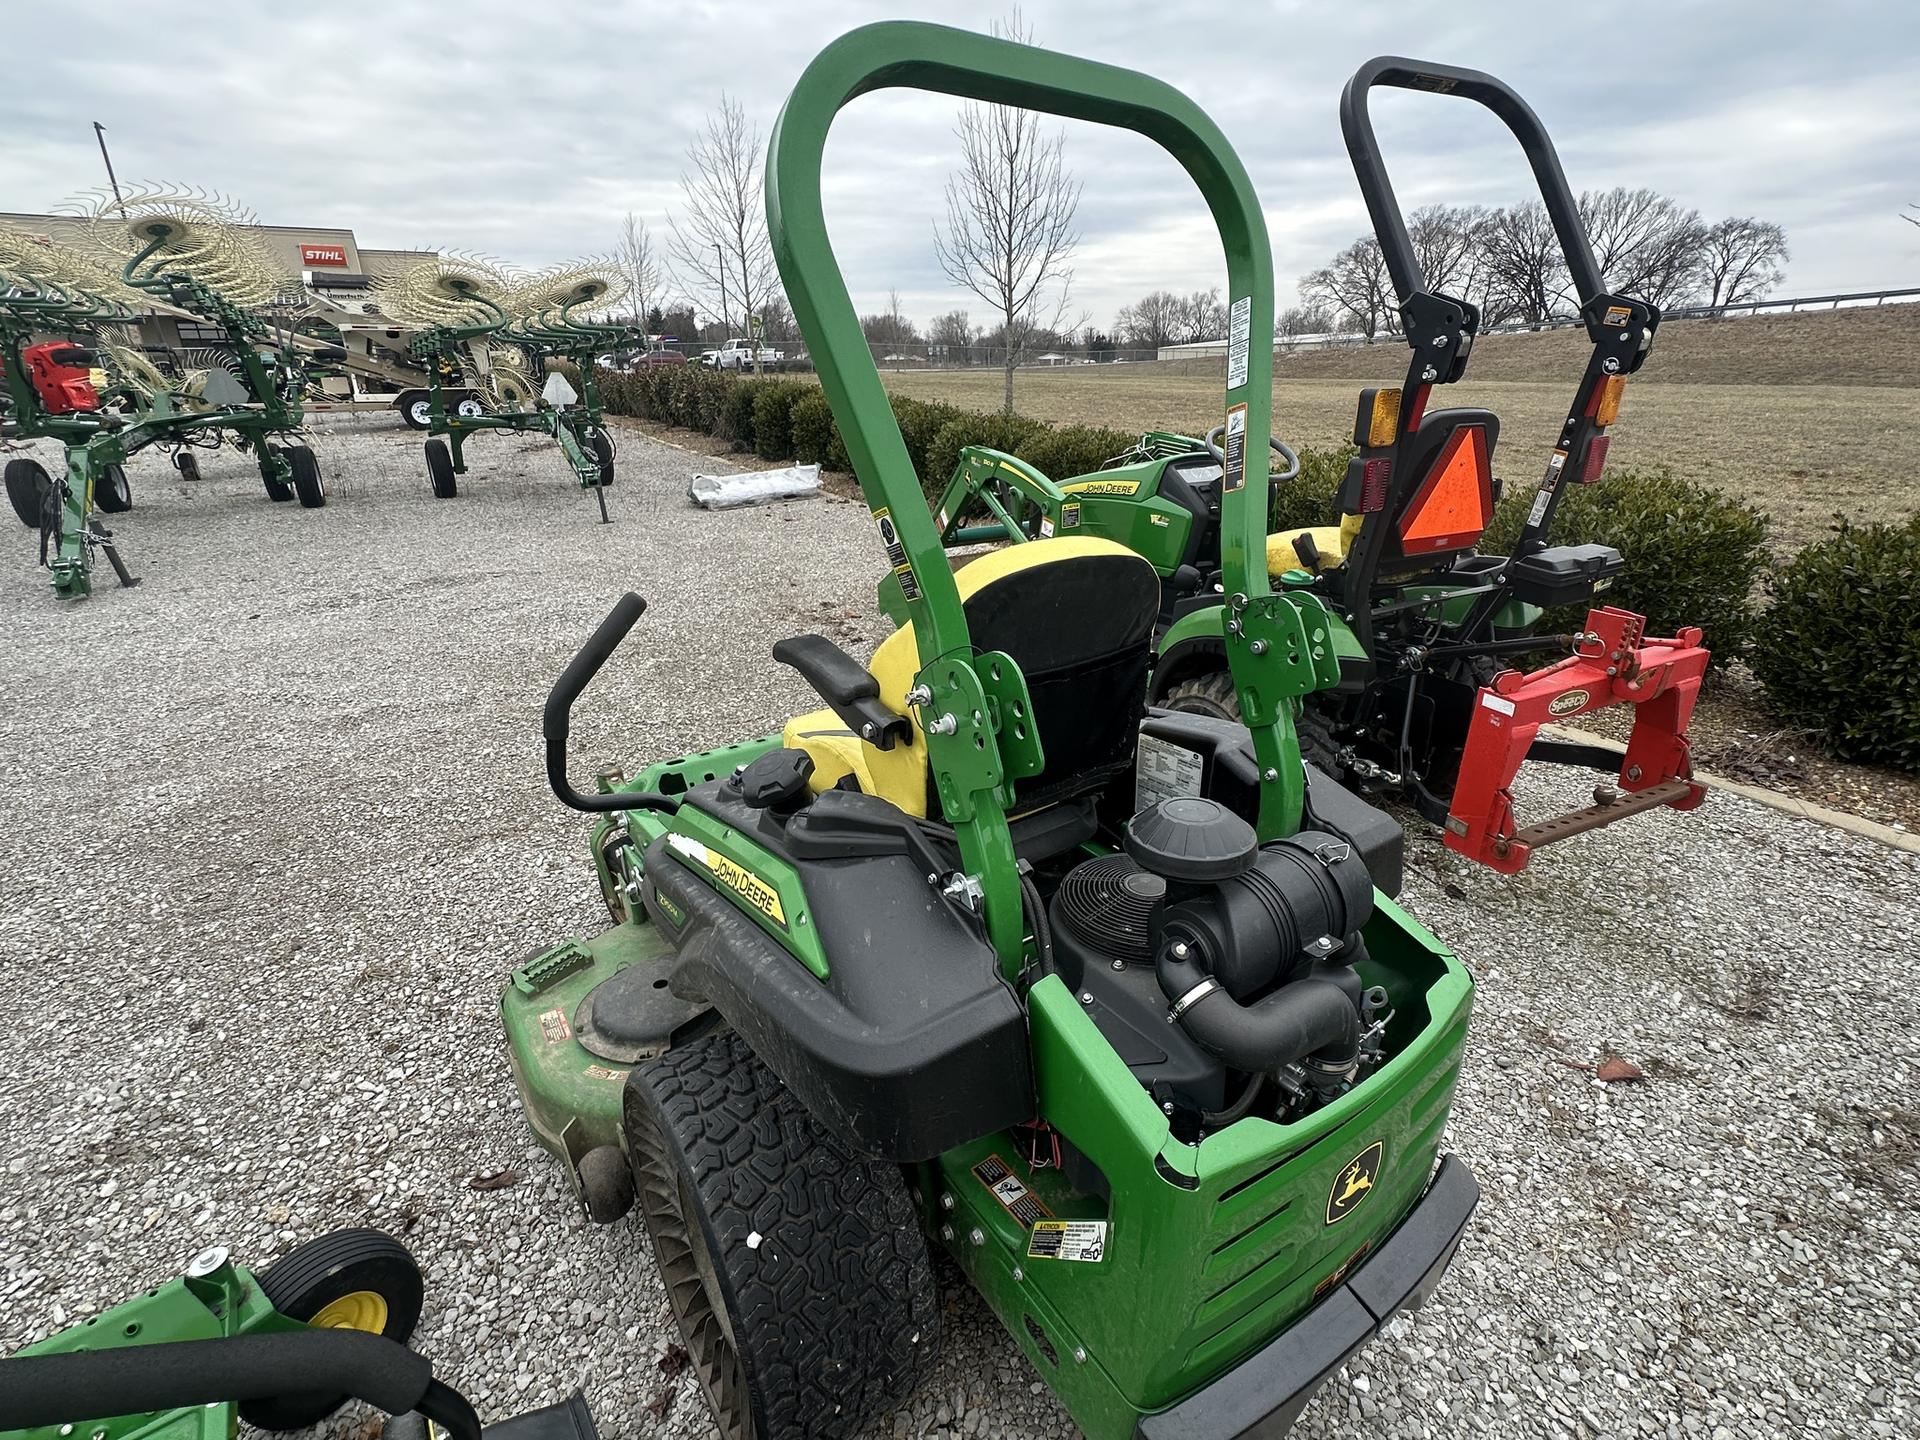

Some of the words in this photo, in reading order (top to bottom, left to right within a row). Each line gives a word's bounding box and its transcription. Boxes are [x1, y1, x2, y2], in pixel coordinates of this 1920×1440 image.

[305, 250, 343, 260] STIHL
[1083, 483, 1105, 494] JOHN
[1105, 482, 1134, 494] DEERE
[713, 857, 739, 887] JOHN
[739, 872, 775, 913] DEERE
